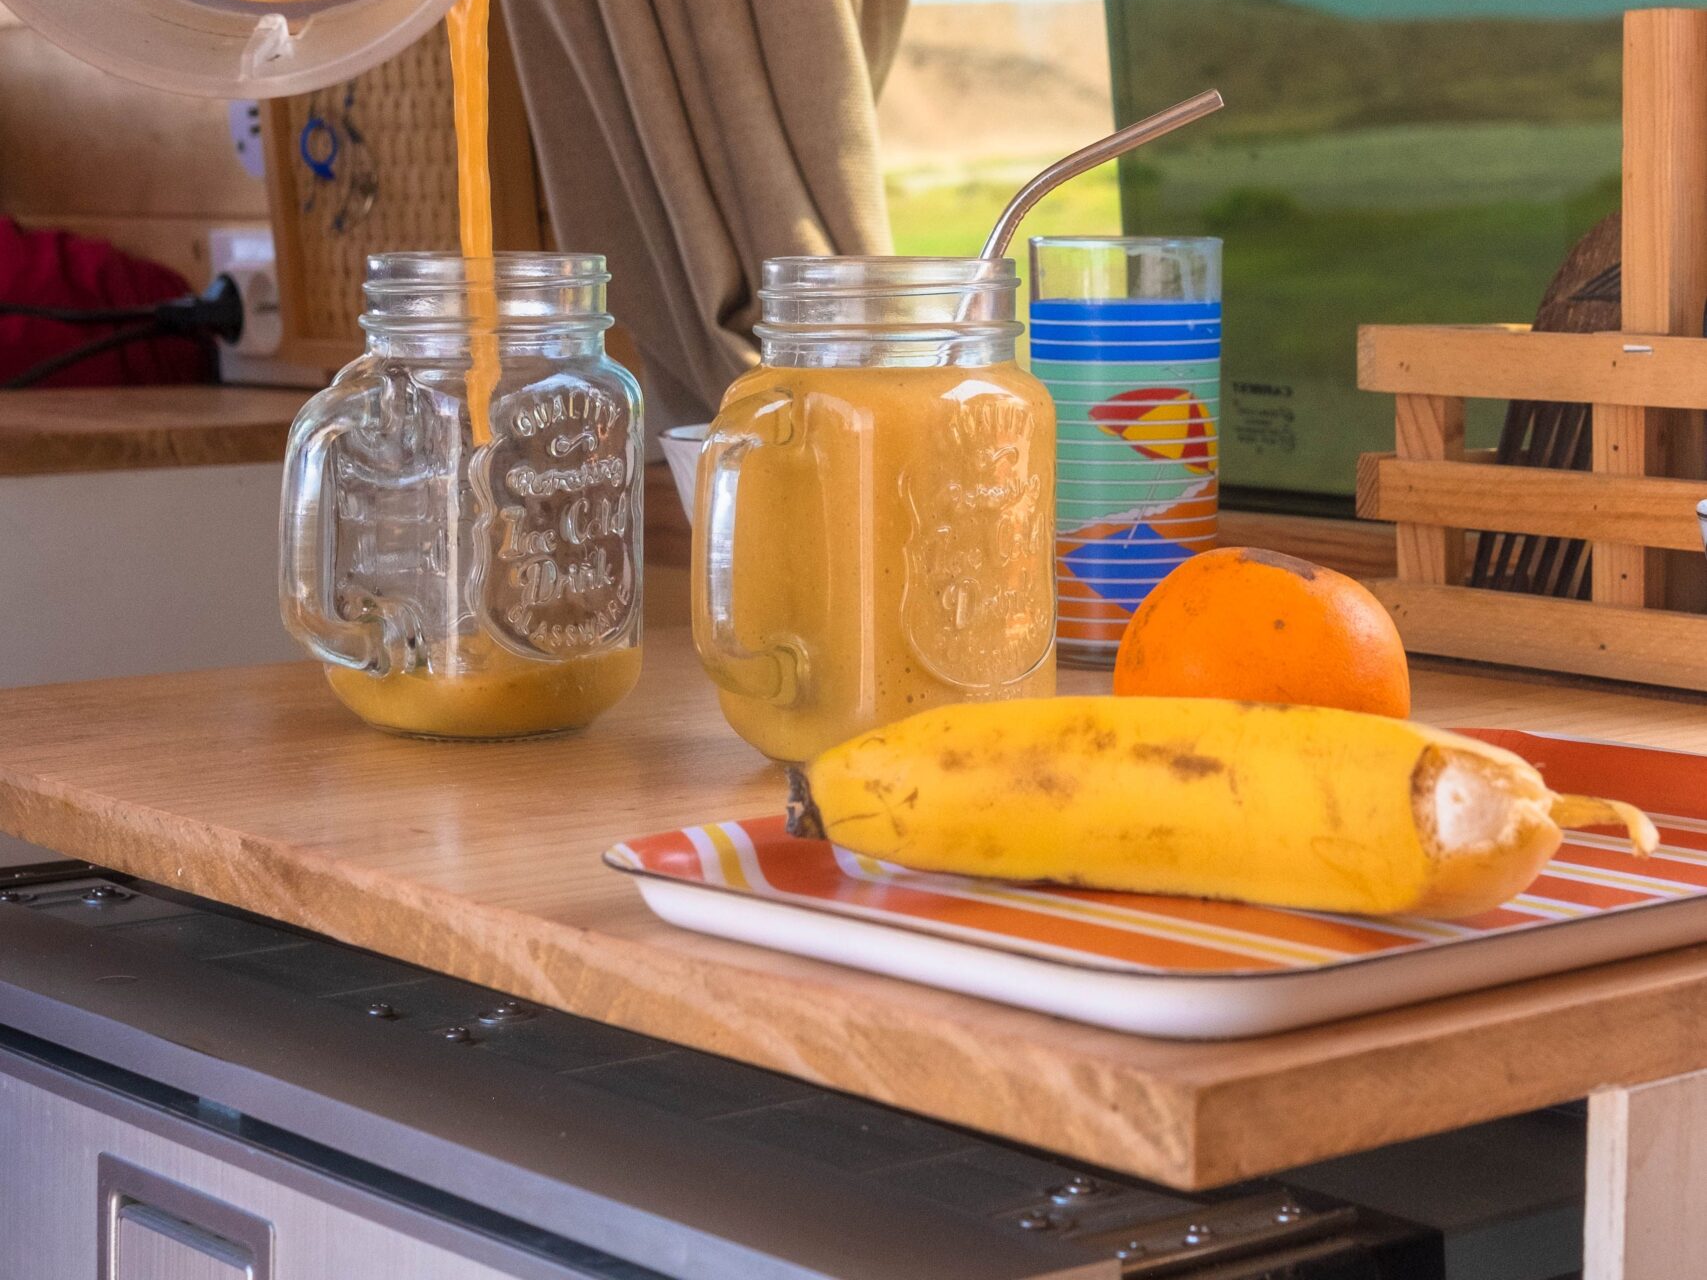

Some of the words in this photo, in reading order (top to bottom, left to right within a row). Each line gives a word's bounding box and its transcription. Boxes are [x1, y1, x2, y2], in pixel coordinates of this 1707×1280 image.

[513, 387, 621, 437] QUALITY
[499, 505, 558, 559] Ice
[561, 490, 627, 546] Cold
[511, 547, 616, 605] Drink
